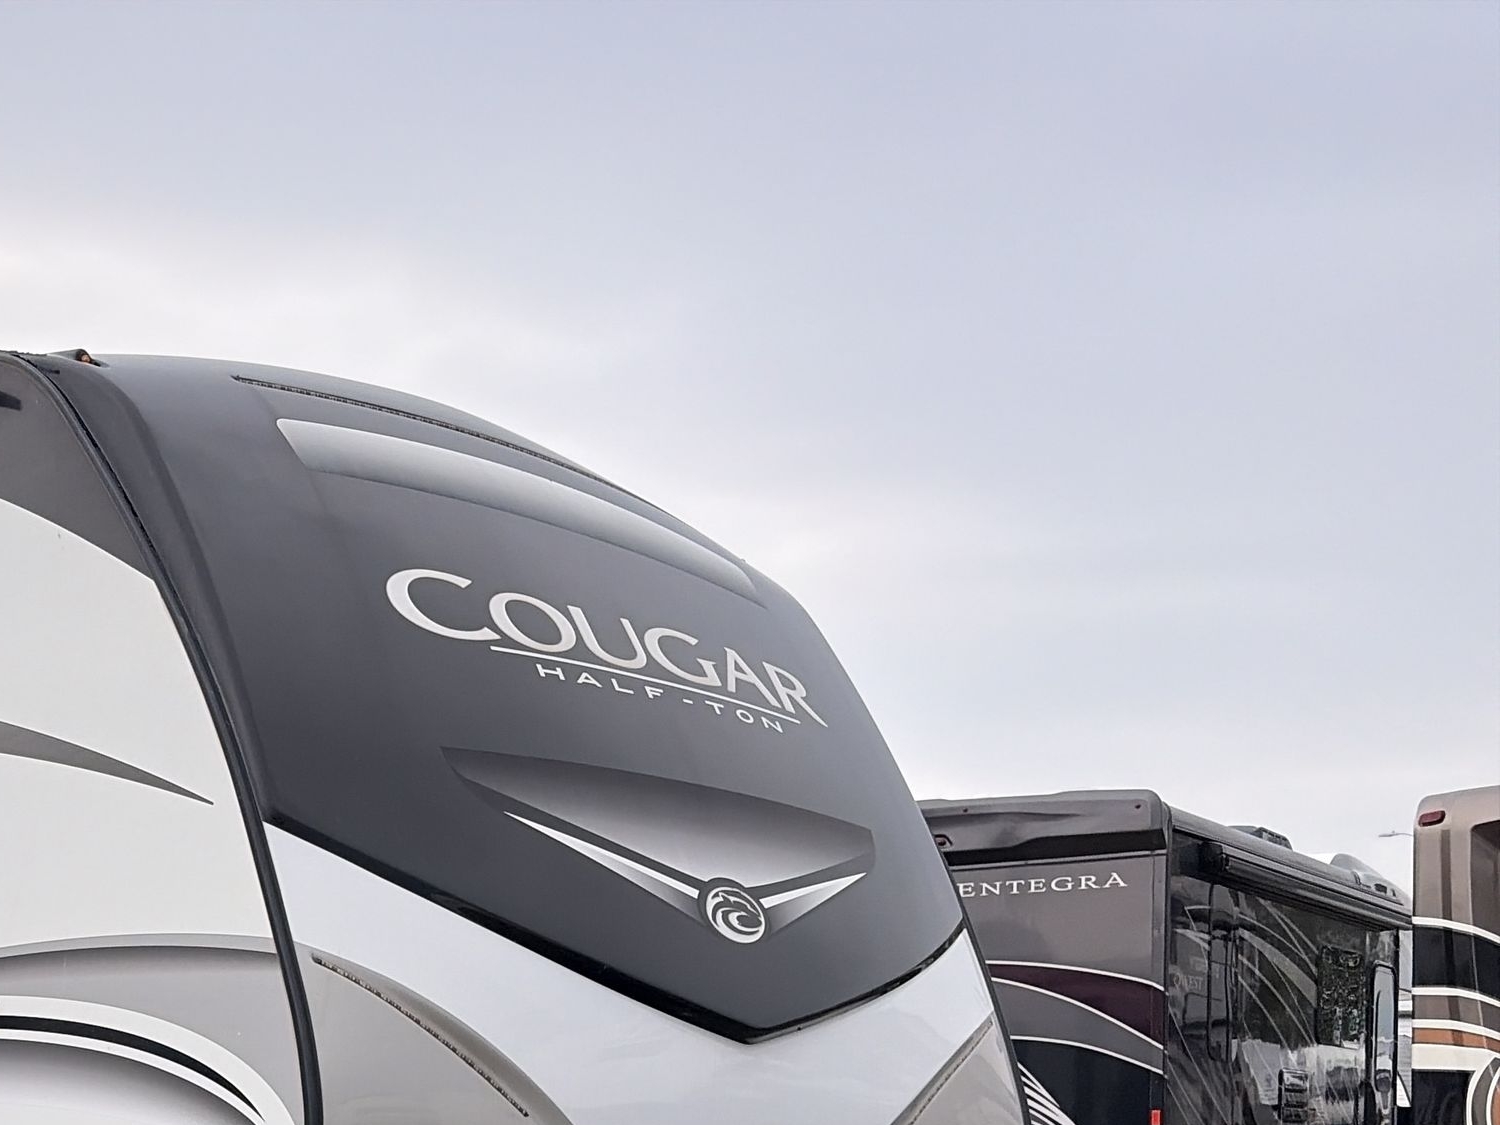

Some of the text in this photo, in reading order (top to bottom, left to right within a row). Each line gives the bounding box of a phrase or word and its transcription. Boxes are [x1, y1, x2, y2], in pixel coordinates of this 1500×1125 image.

[385, 568, 829, 728] COUGAR
[535, 663, 785, 734] HALF-TON
[956, 872, 1128, 898] ENTEGRA
